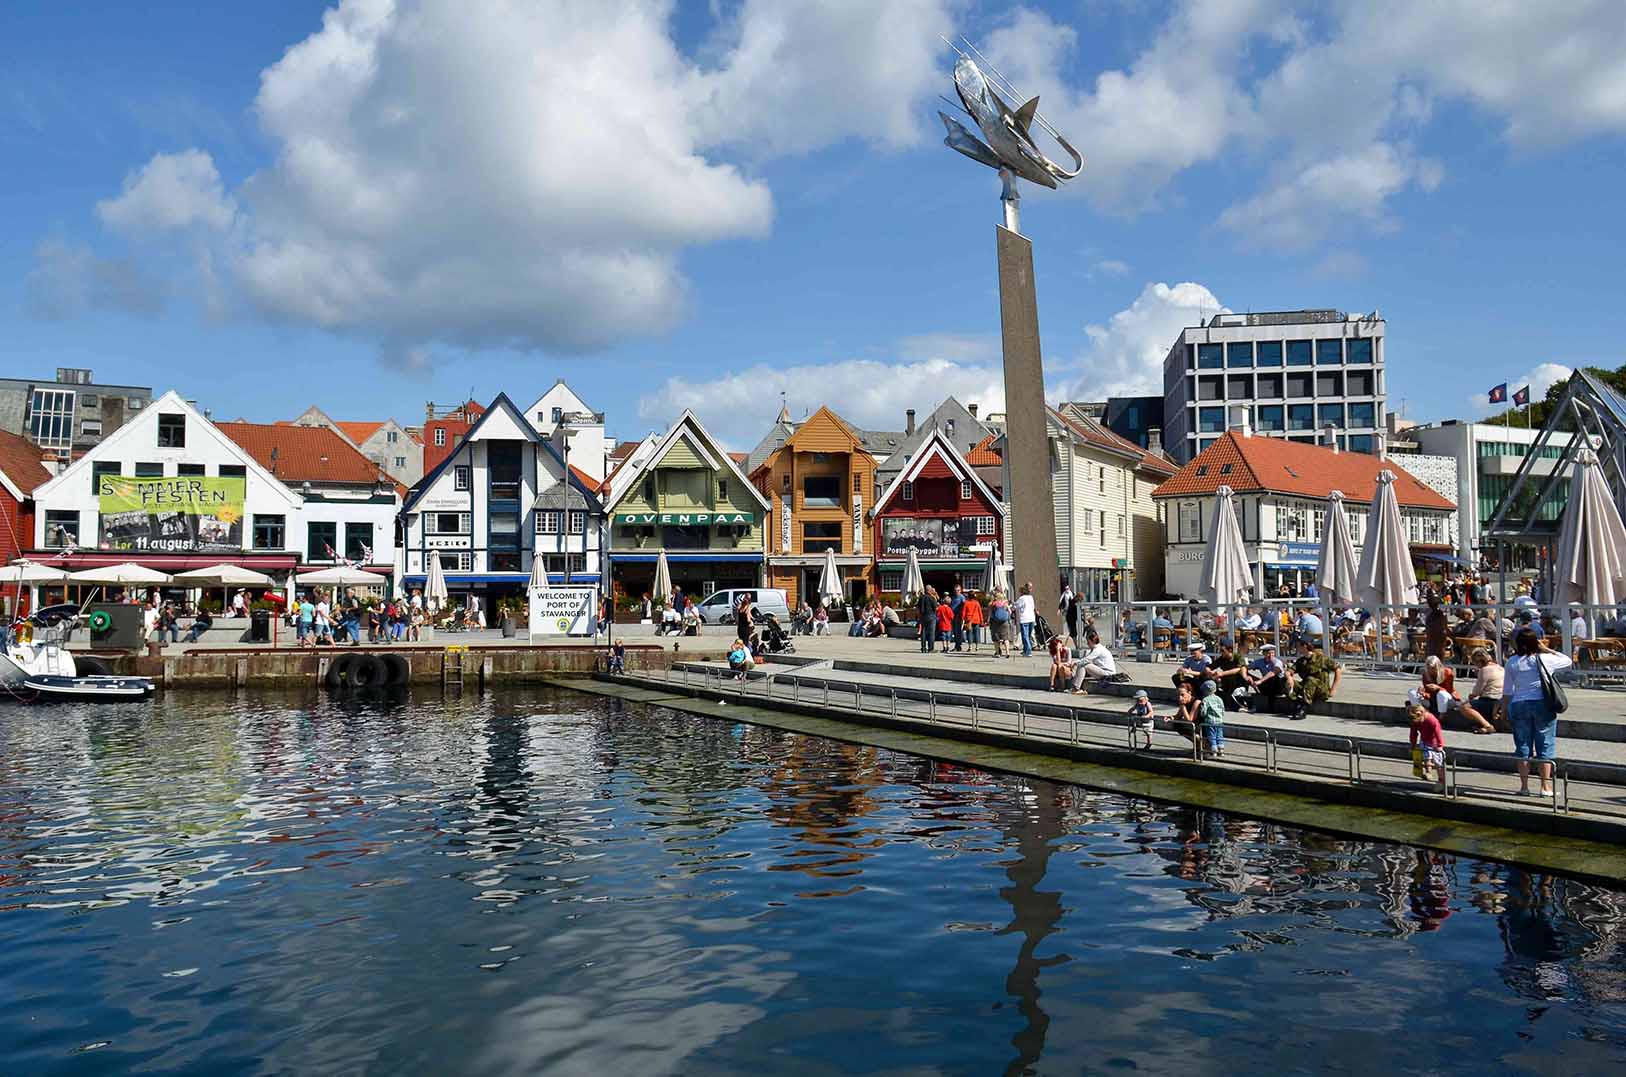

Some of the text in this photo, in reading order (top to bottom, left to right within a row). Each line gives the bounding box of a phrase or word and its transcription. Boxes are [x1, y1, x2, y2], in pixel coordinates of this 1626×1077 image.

[142, 490, 226, 504] FESTEN
[625, 514, 745, 523] OVENPAA
[1178, 552, 1205, 561] BURG
